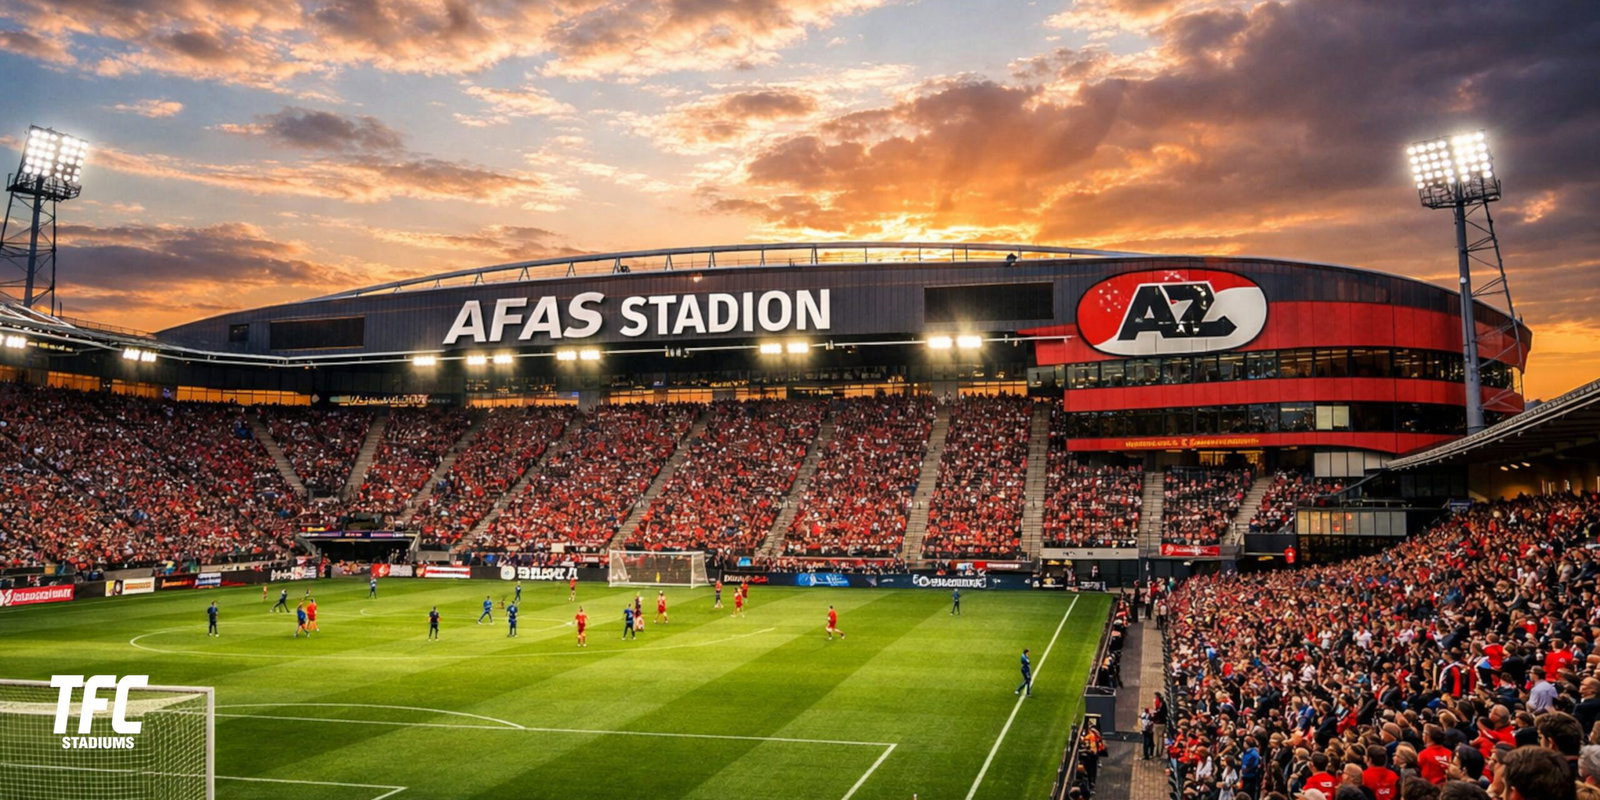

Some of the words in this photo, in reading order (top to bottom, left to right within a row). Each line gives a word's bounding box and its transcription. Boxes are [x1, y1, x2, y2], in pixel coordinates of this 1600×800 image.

[442, 292, 605, 344] AFAS
[619, 288, 830, 337] STADION
[1117, 282, 1237, 341] AZ
